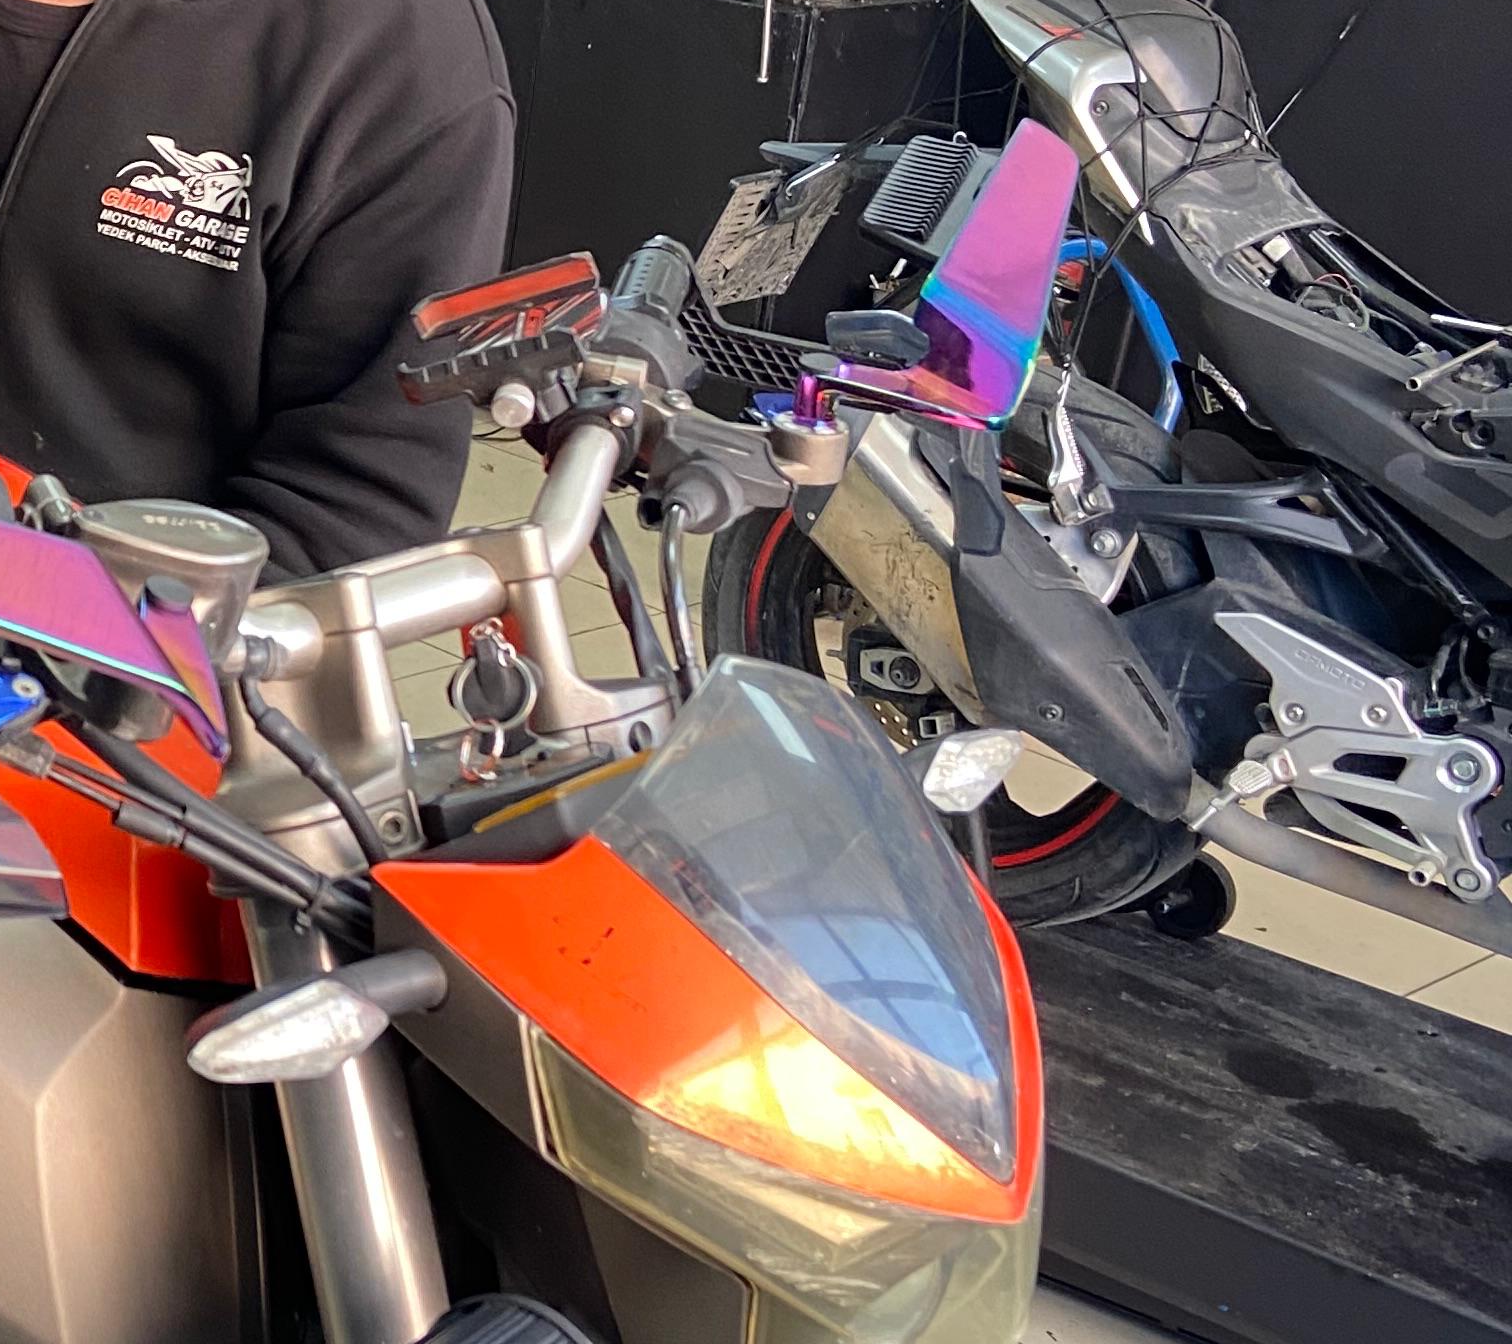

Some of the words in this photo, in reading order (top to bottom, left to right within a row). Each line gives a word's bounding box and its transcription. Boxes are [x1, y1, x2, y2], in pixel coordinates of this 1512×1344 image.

[96, 222, 136, 242] YEDEK
[135, 235, 177, 255] PARÇA
[99, 208, 185, 242] MOTOSİKLET
